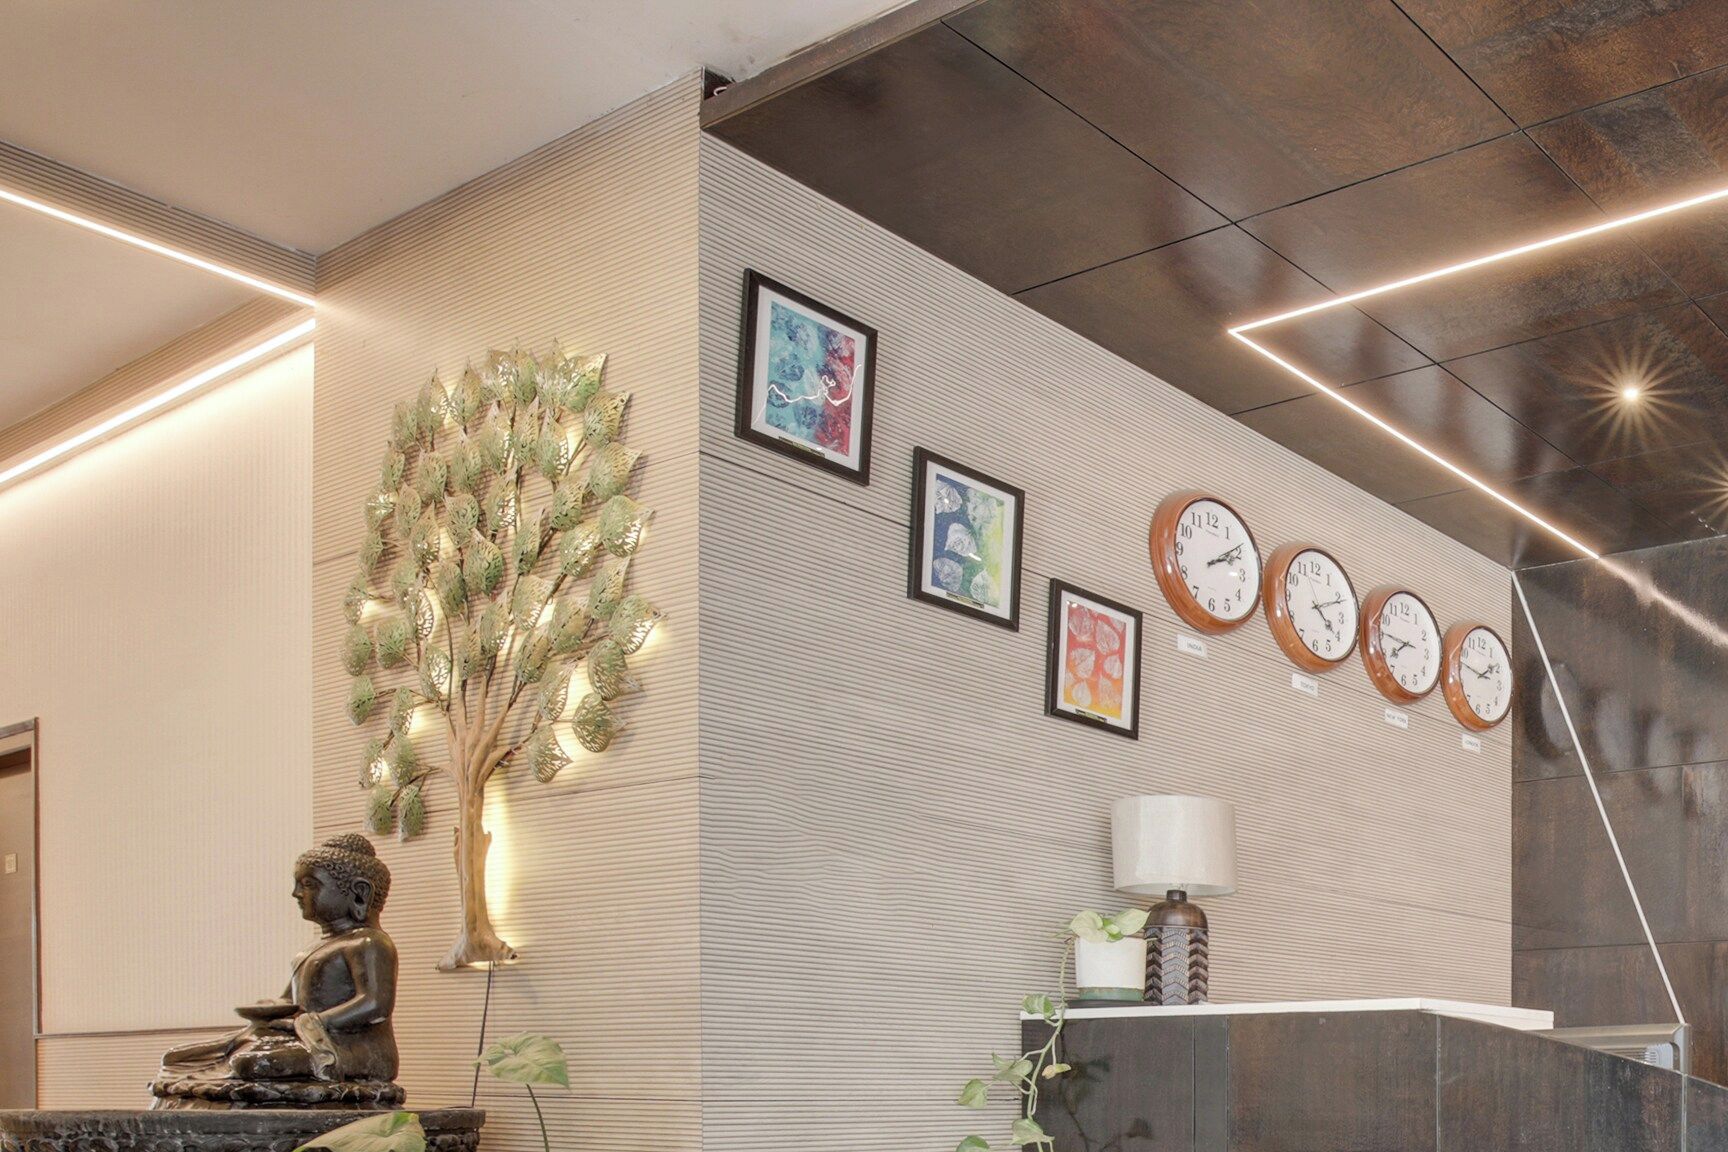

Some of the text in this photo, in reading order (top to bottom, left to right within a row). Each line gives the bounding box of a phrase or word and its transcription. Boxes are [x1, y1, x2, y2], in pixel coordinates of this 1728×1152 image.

[1191, 512, 1202, 528] 11
[1206, 512, 1218, 528] 12
[1181, 523, 1192, 539] 10
[1225, 527, 1230, 539] 1
[1176, 542, 1183, 556] 9
[1236, 548, 1242, 560] 2
[1181, 565, 1188, 579] 8
[1298, 562, 1306, 576] 11
[1310, 562, 1320, 576] 12
[1240, 569, 1245, 582] 3
[1289, 573, 1298, 586] 10
[1327, 574, 1330, 585] 1
[1193, 586, 1199, 598] 7
[1235, 588, 1241, 600] 4
[1335, 592, 1341, 603] 2
[1208, 598, 1215, 611] 6
[1224, 599, 1231, 612] 5
[1390, 603, 1397, 616] 11
[1400, 602, 1409, 616] 12
[1339, 612, 1344, 624] 3
[1382, 613, 1390, 626] 10
[1300, 628, 1305, 639] 7
[1335, 631, 1340, 641] 4
[1422, 630, 1426, 641] 2
[1312, 640, 1318, 652] 6
[1326, 640, 1331, 652] 5
[1469, 637, 1475, 650] 11
[1478, 637, 1486, 649] 12
[1424, 649, 1429, 660] 3
[1390, 665, 1395, 674] 7
[1422, 666, 1425, 676] 4
[1495, 663, 1500, 674] 2
[1401, 674, 1406, 686] 6
[1413, 674, 1417, 686] 5
[1476, 704, 1480, 714] 6
[1486, 704, 1490, 714] 5
